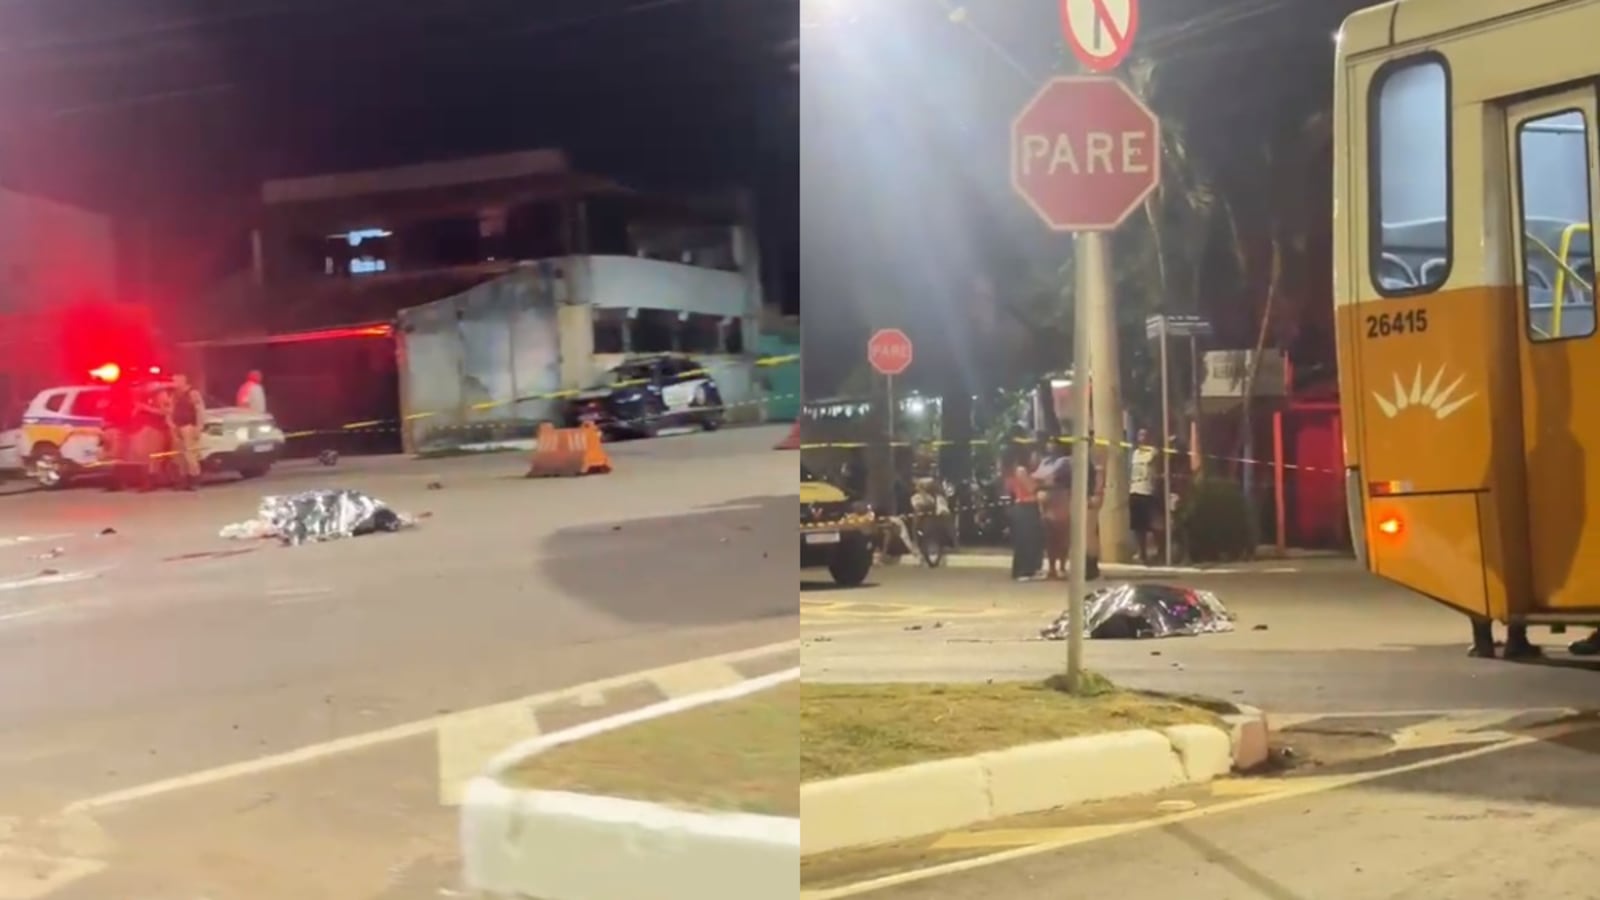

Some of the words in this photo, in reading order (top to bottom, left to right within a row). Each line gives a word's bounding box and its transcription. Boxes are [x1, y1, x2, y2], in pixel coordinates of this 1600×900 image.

[1022, 131, 1149, 175] PARE
[1366, 308, 1428, 338] 26415
[872, 343, 907, 358] PARE
